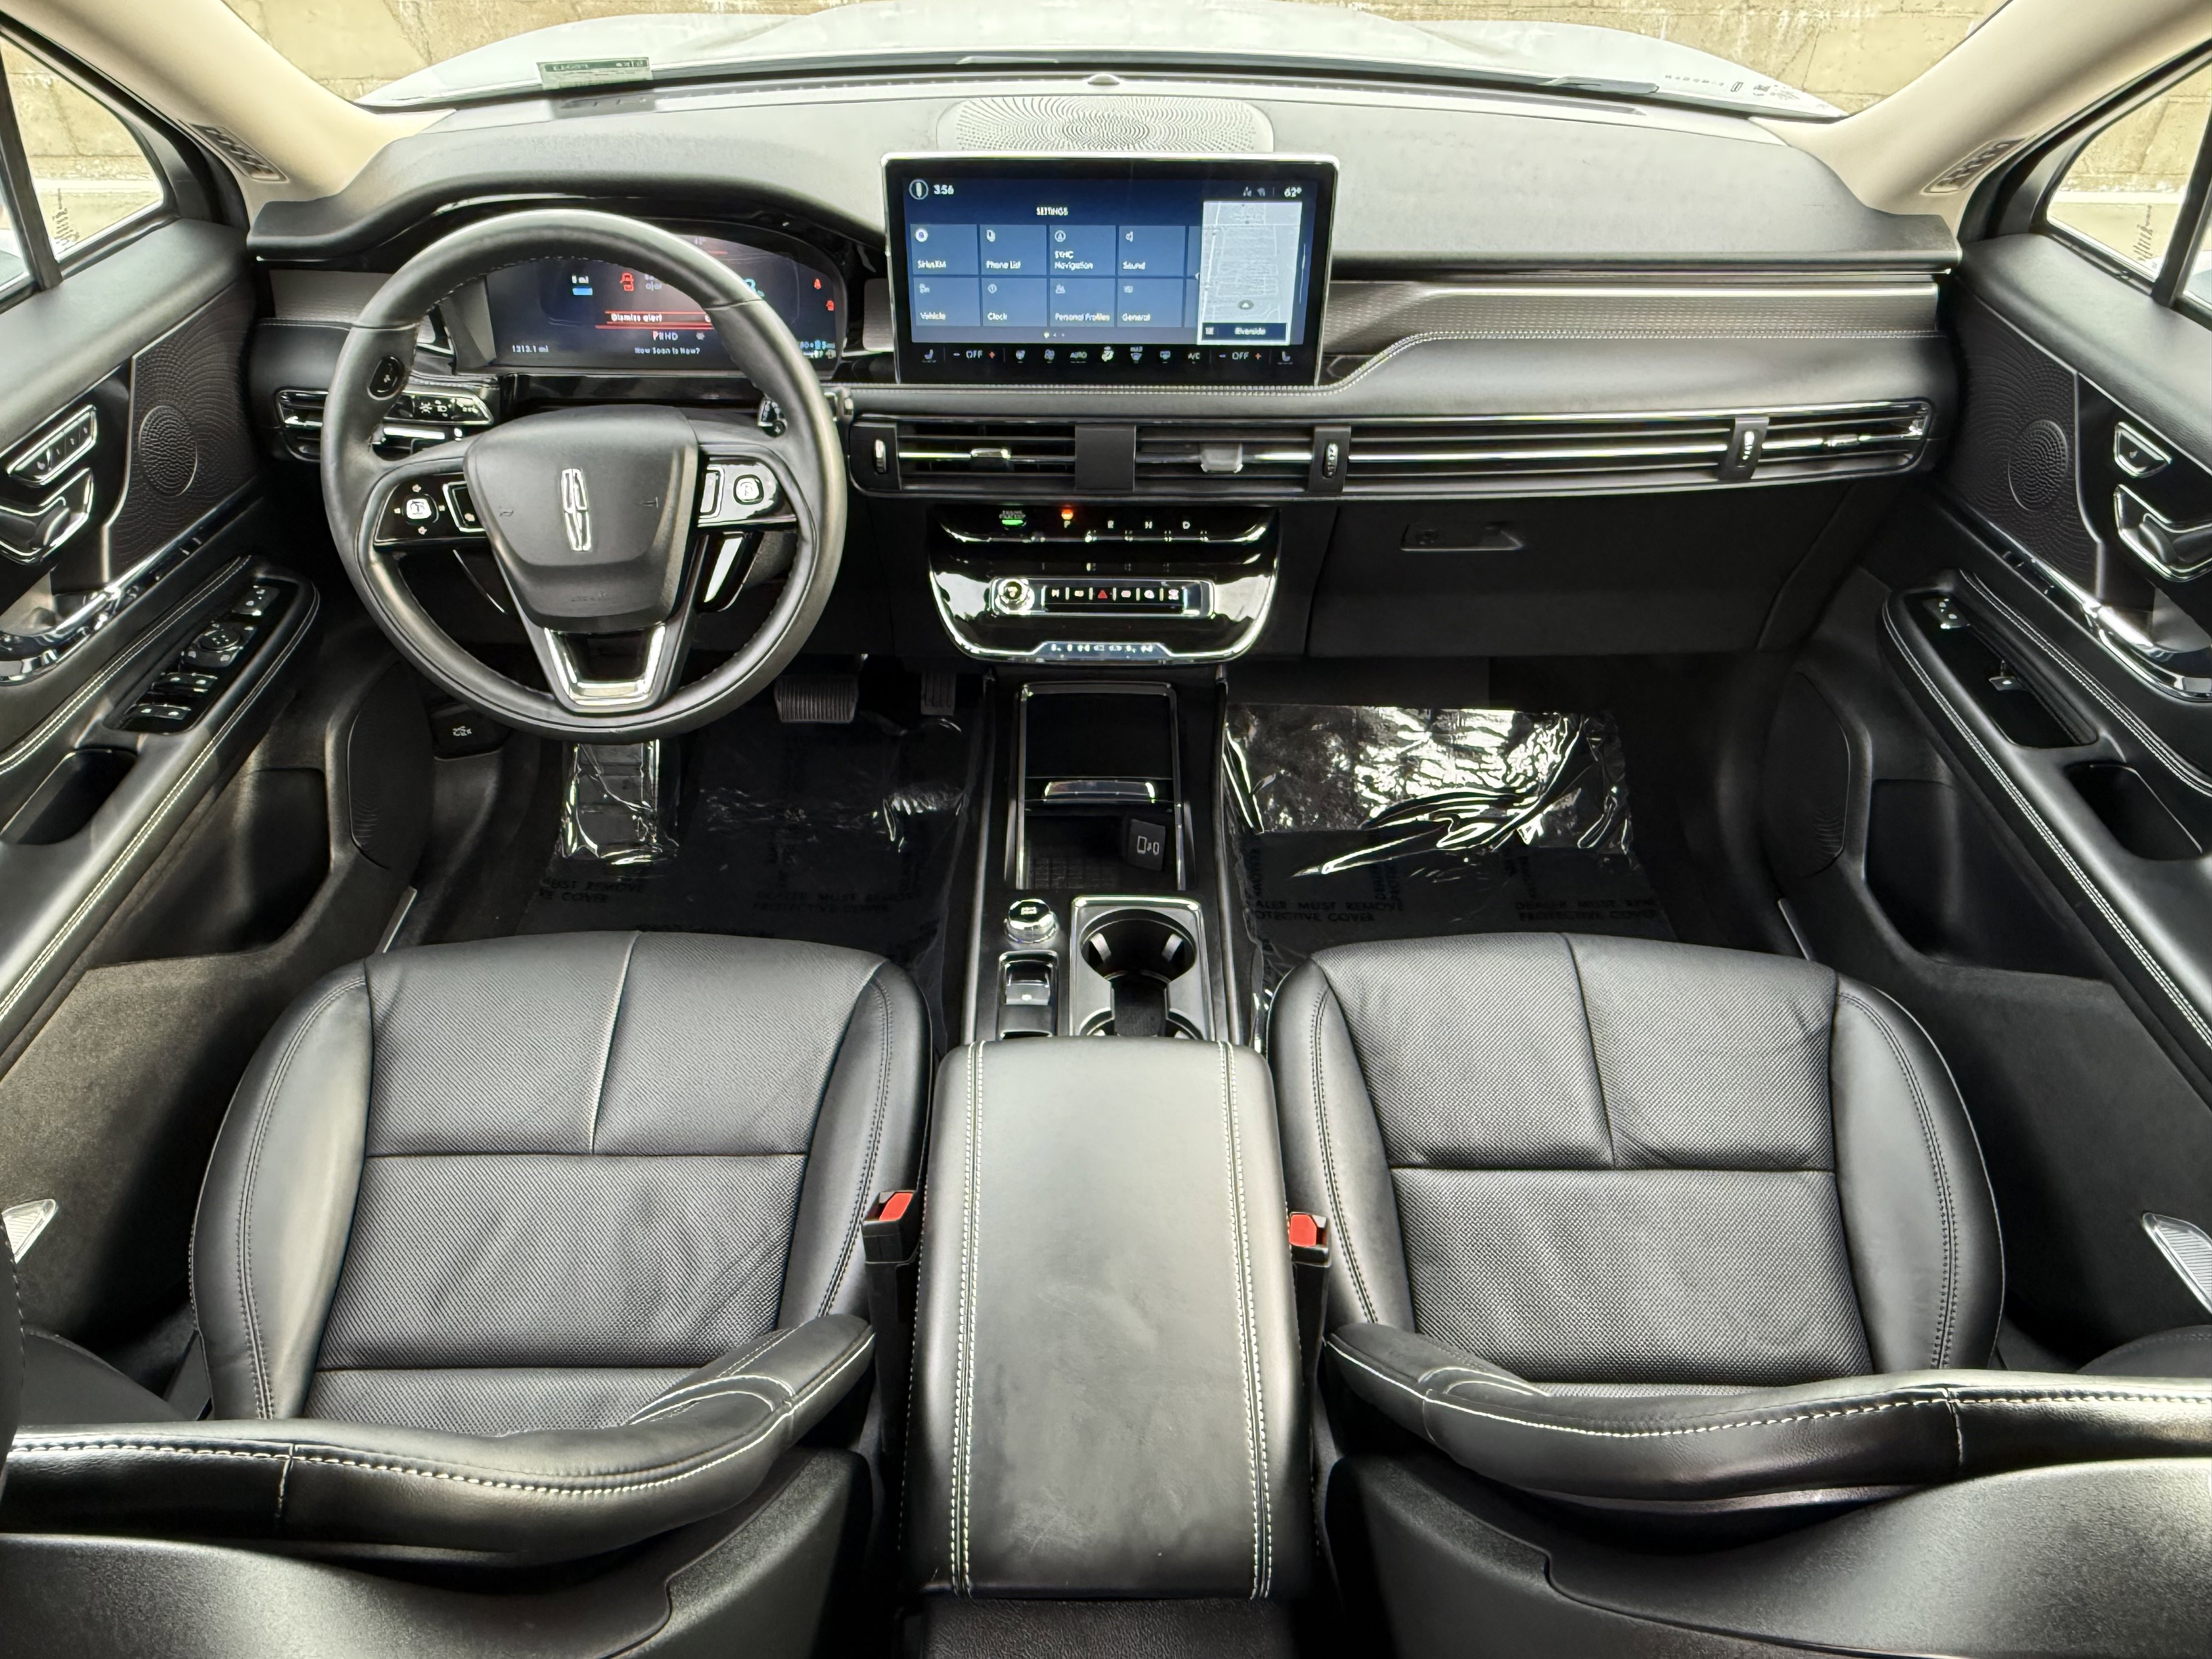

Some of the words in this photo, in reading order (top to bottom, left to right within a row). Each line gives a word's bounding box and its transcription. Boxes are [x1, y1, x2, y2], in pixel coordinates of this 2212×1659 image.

[1036, 206, 1069, 216] SETTINGS
[986, 260, 1008, 269] Phone
[1054, 261, 1093, 270] Navigation
[1122, 261, 1146, 270] Sound
[987, 312, 1008, 320] Clock
[1055, 313, 1084, 321] Personal
[1122, 313, 1151, 321] General
[966, 349, 983, 359] OFF
[1232, 351, 1250, 360] OFF
[1298, 901, 1336, 911] MUST
[1327, 912, 1375, 922] COVER
